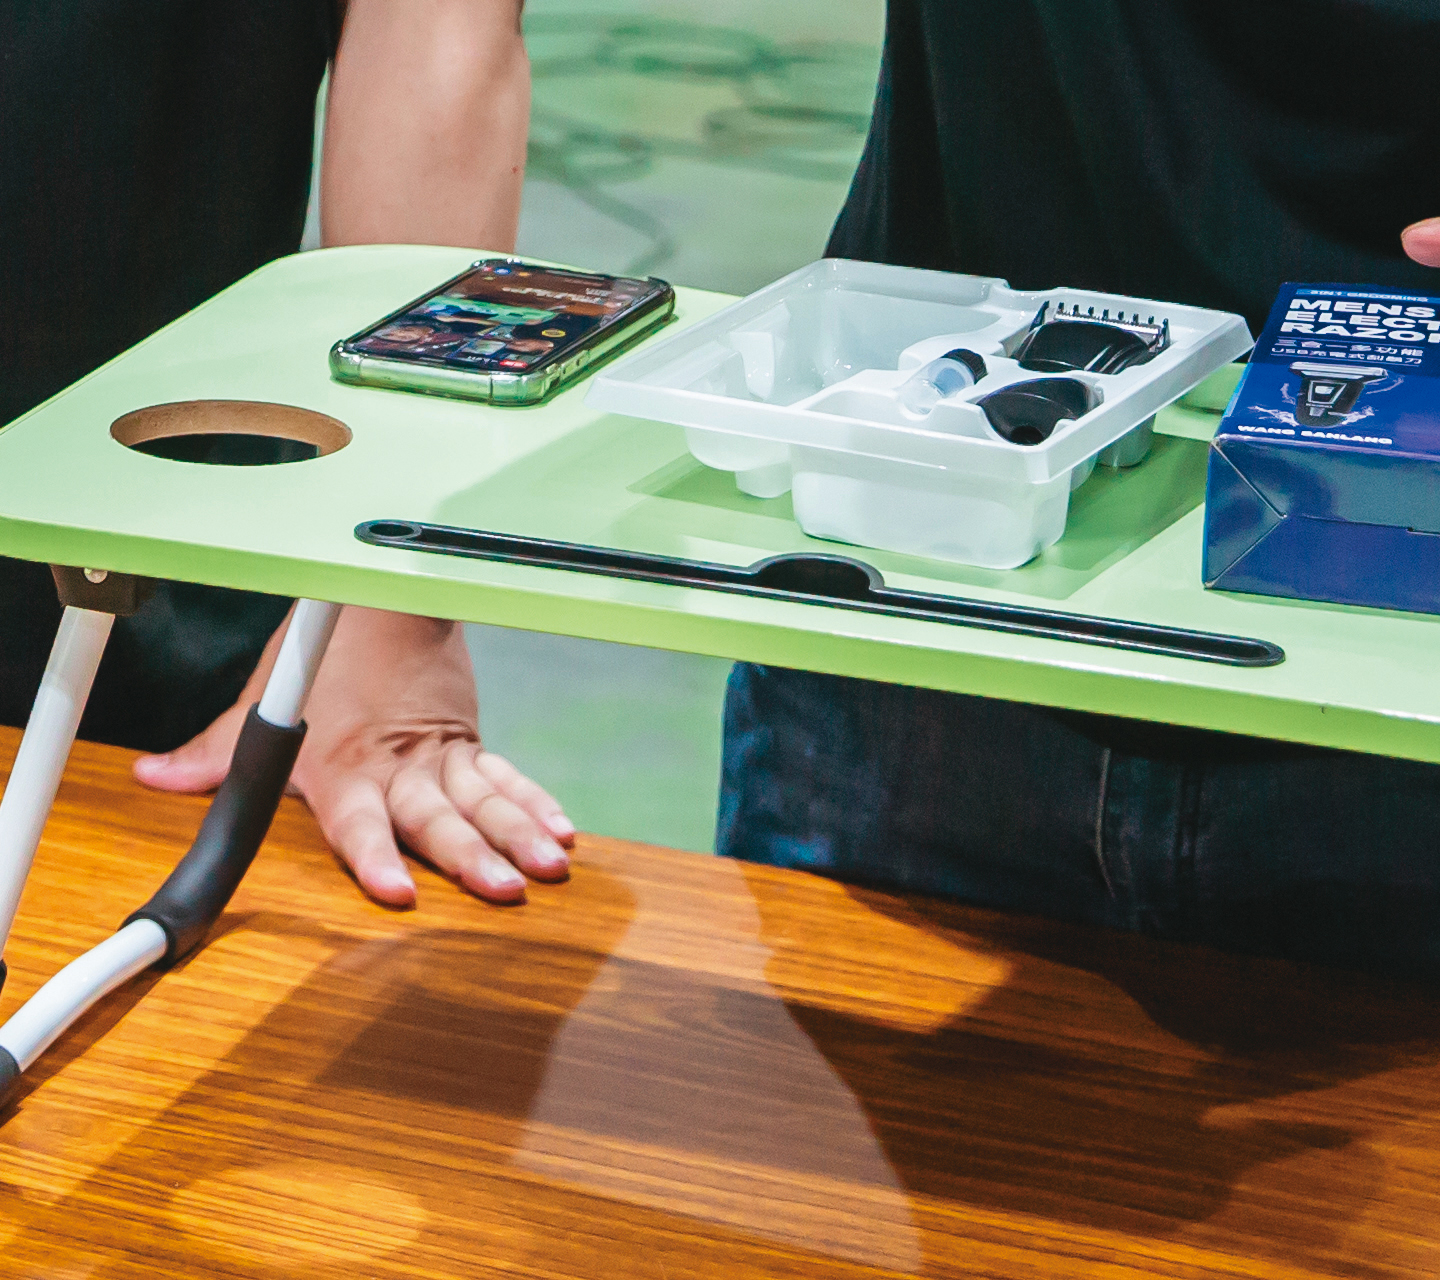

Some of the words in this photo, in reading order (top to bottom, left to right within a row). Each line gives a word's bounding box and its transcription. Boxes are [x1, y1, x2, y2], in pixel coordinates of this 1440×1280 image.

[1289, 298, 1436, 318] MENS
[1273, 339, 1425, 358] 三合一多功能
